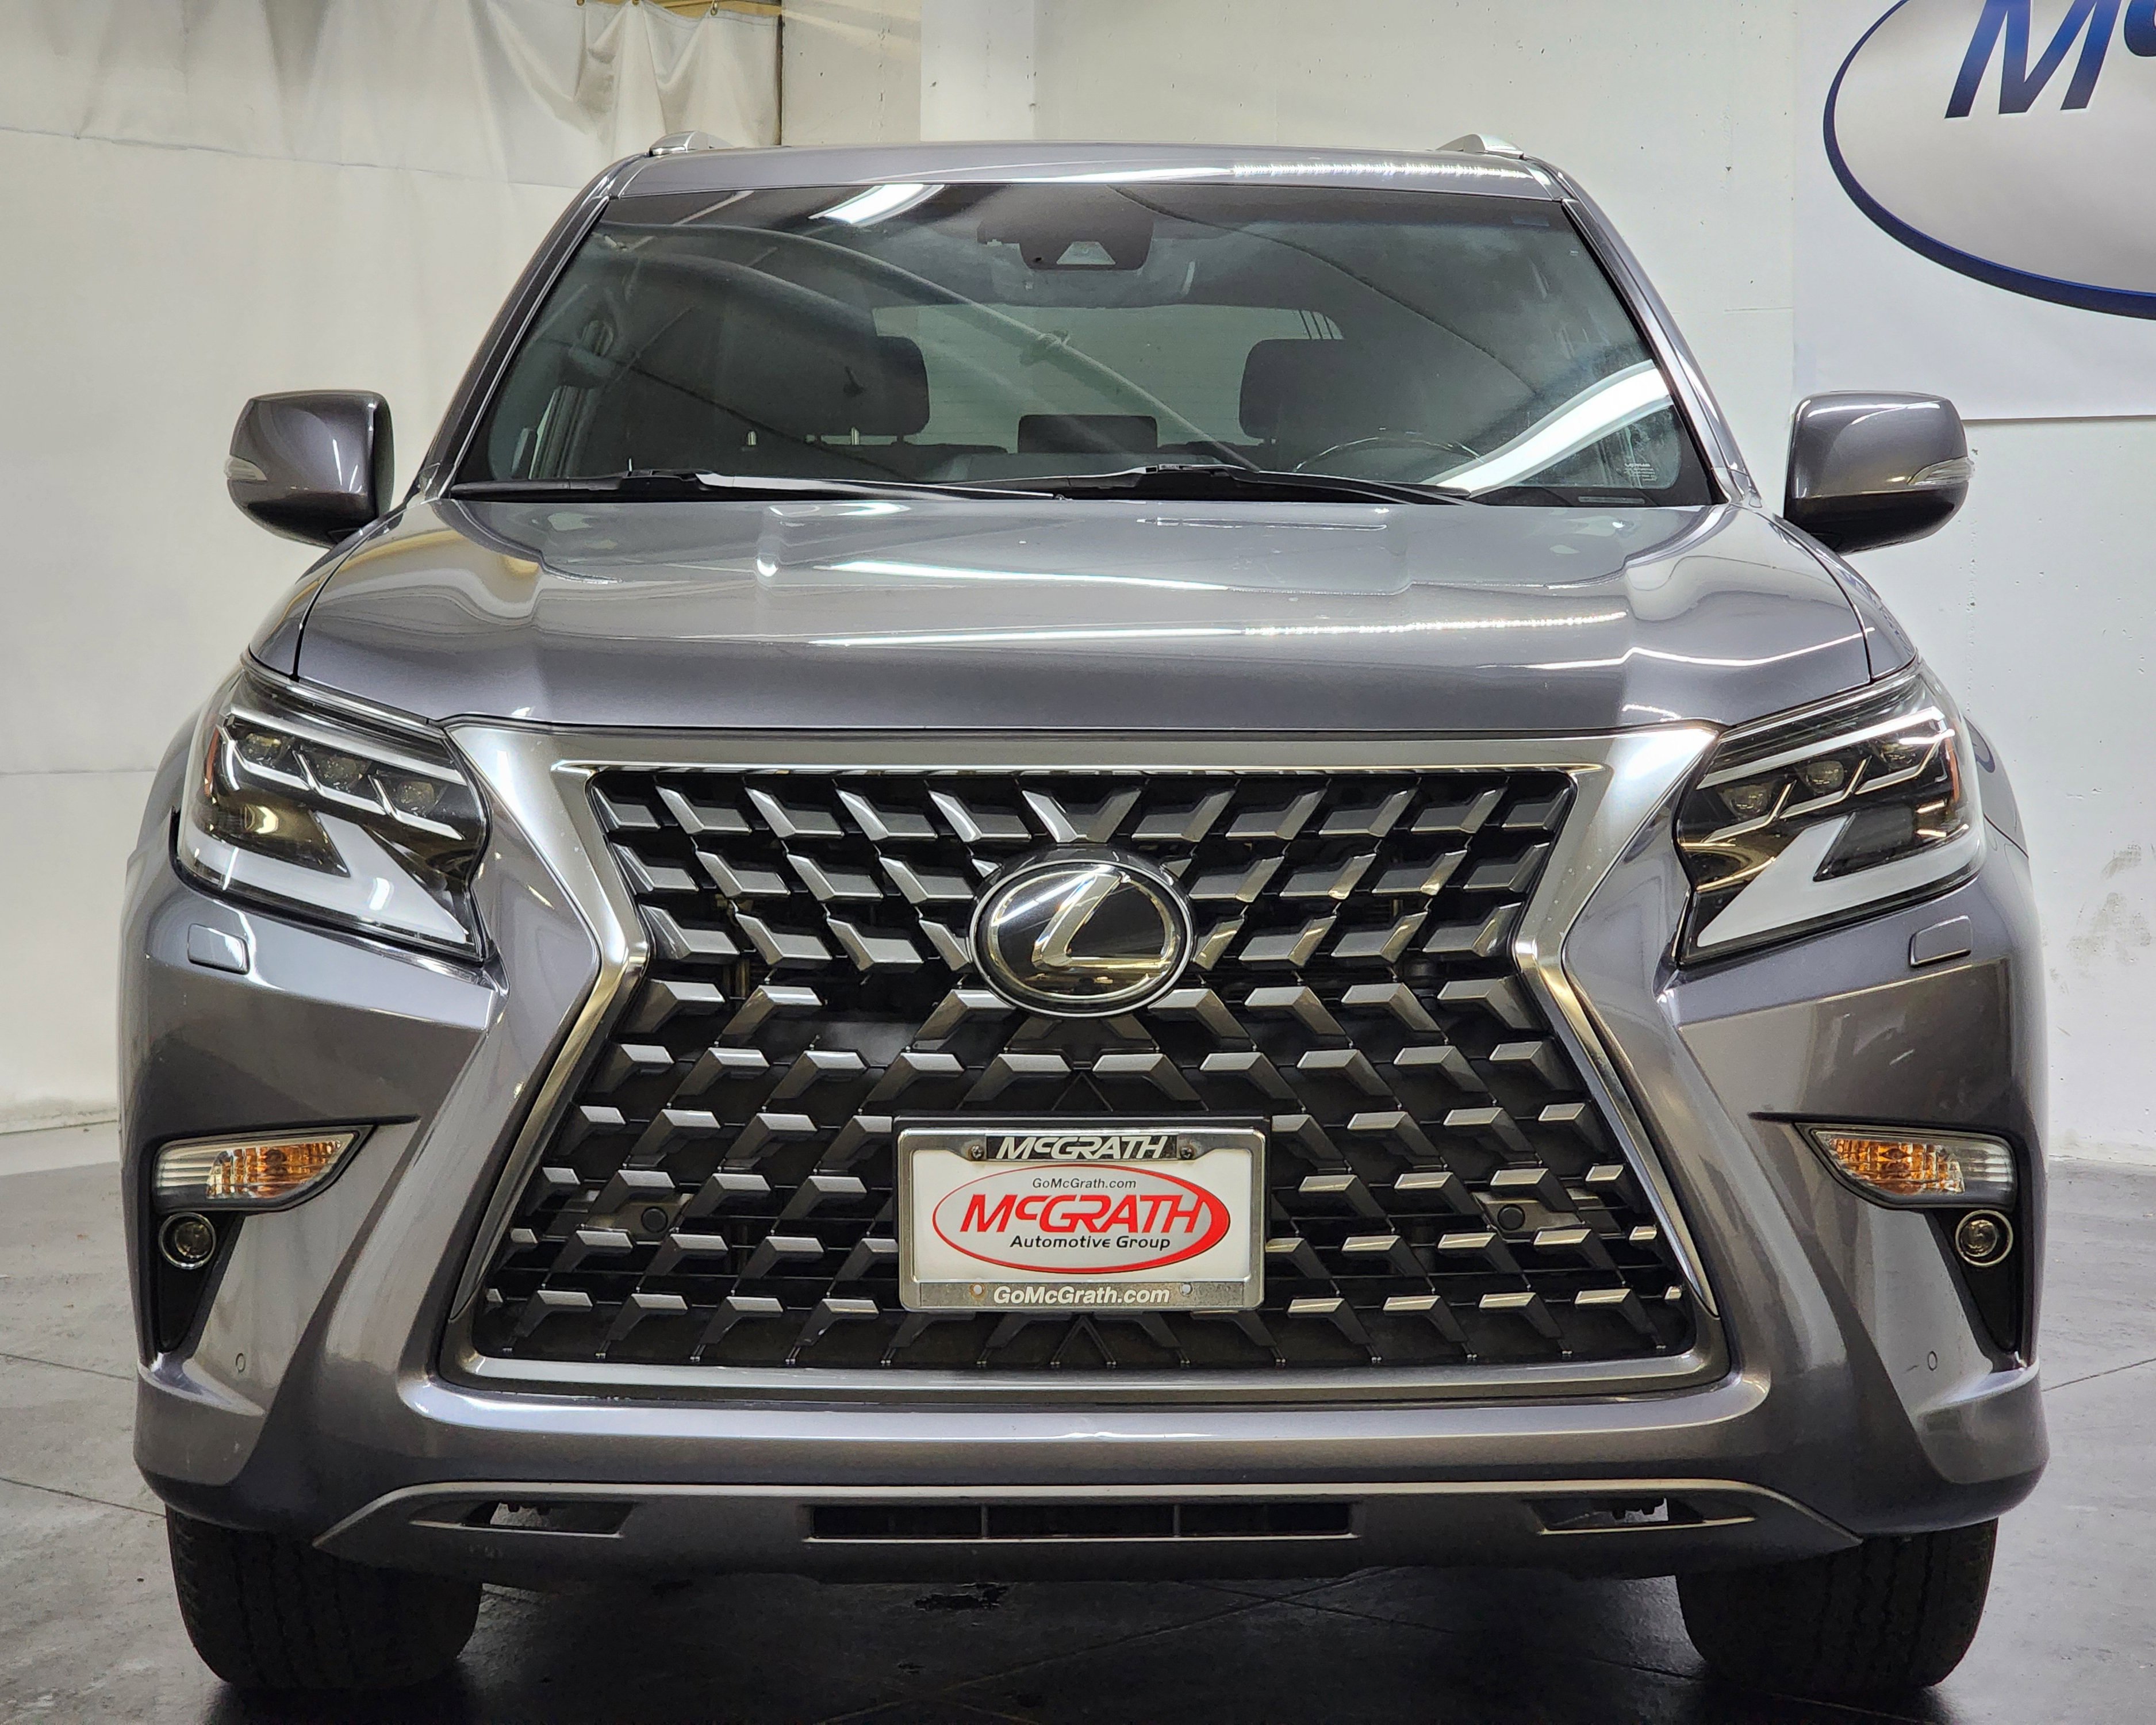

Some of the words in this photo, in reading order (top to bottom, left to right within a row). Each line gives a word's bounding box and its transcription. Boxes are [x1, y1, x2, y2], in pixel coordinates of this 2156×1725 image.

[1032, 1178, 1137, 1189] GoMcGrath.com
[1010, 1235, 1111, 1248] Automotive
[1116, 1235, 1171, 1251] Group
[993, 1286, 1170, 1305] GoMcGrath.com
